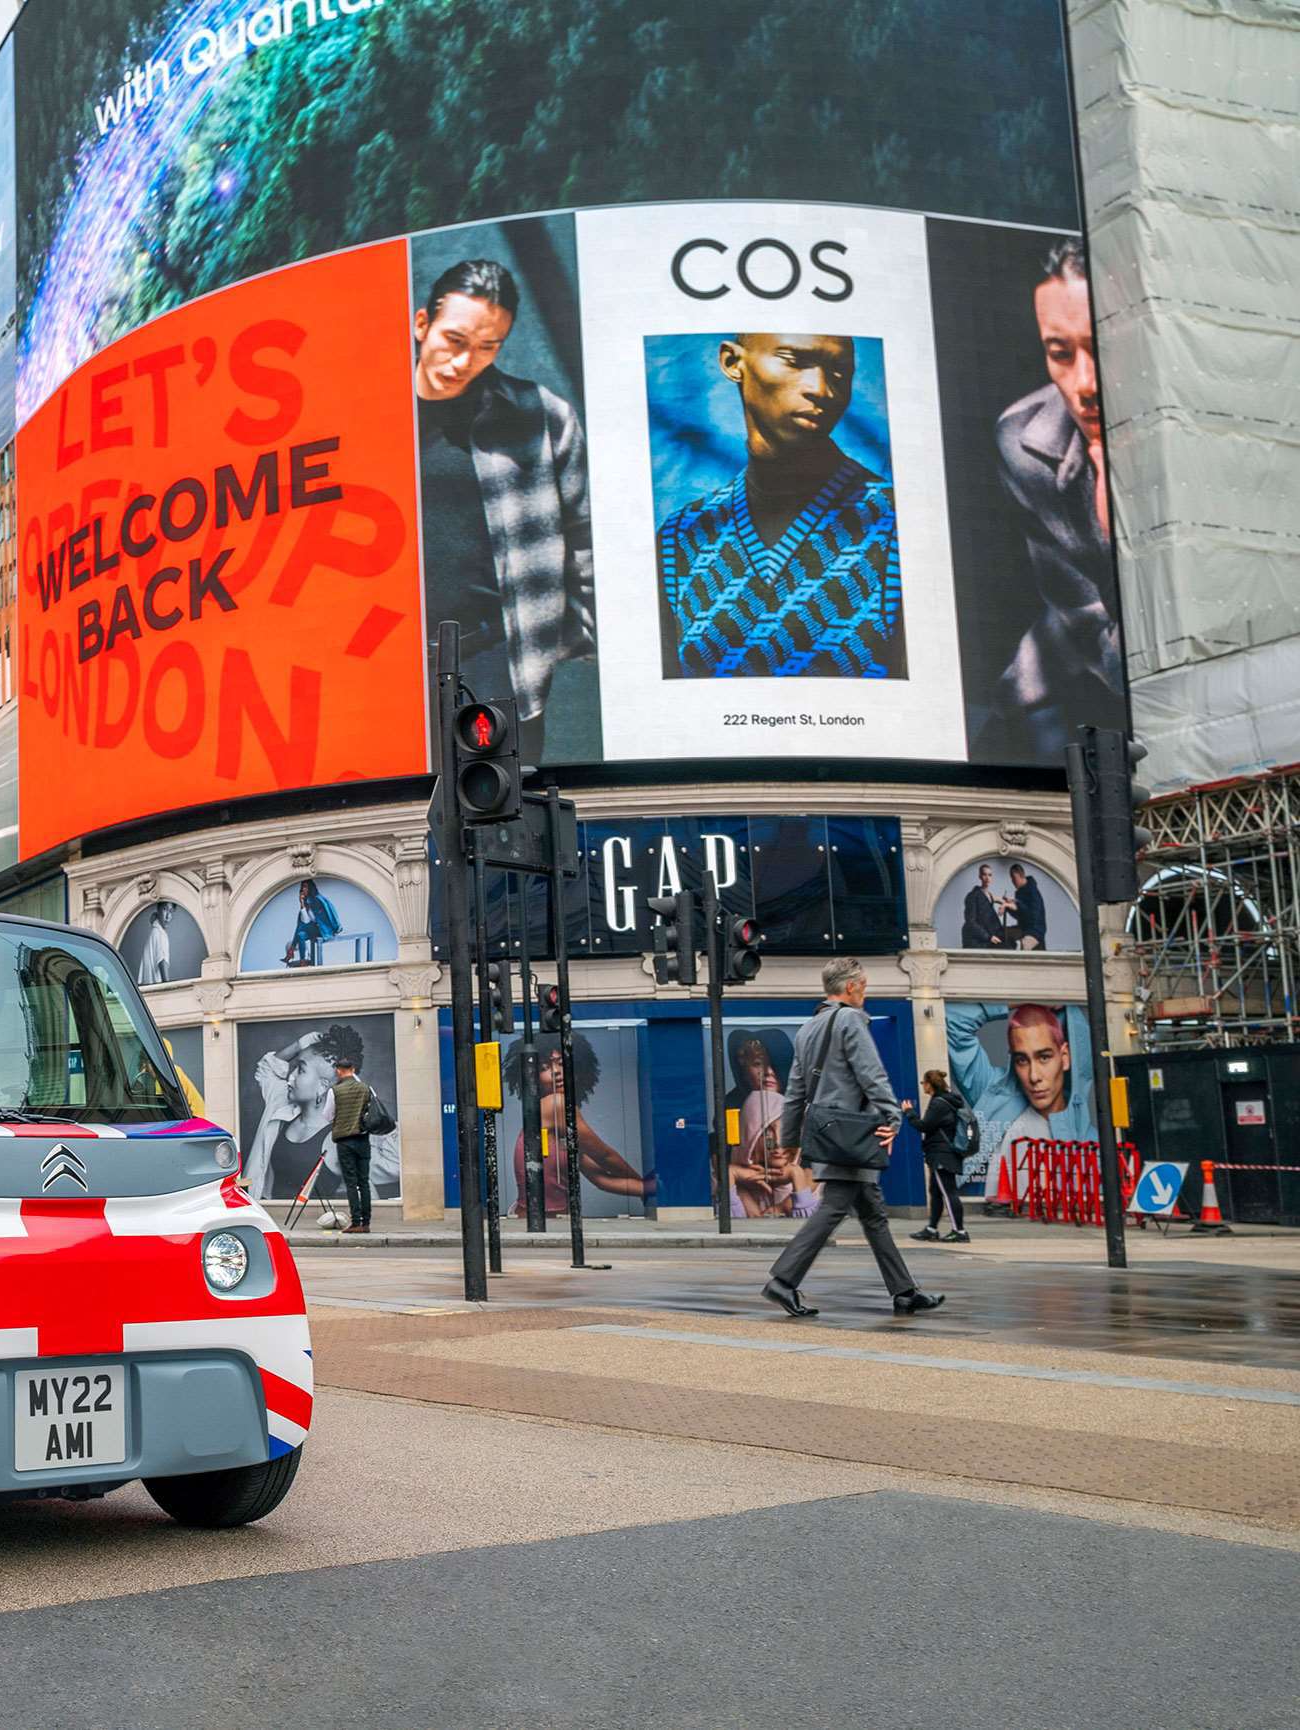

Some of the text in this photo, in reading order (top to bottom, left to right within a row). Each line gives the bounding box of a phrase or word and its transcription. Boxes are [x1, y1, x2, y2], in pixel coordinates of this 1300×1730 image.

[94, 56, 170, 136] with
[671, 237, 855, 302] COS
[56, 318, 308, 472] LET'S
[37, 435, 342, 612] WELCOME
[76, 548, 239, 664] BACK
[723, 714, 866, 728] 222 Regent St, London
[603, 834, 737, 932] GAP
[28, 1374, 112, 1417] MY22
[45, 1421, 93, 1461] AMI
